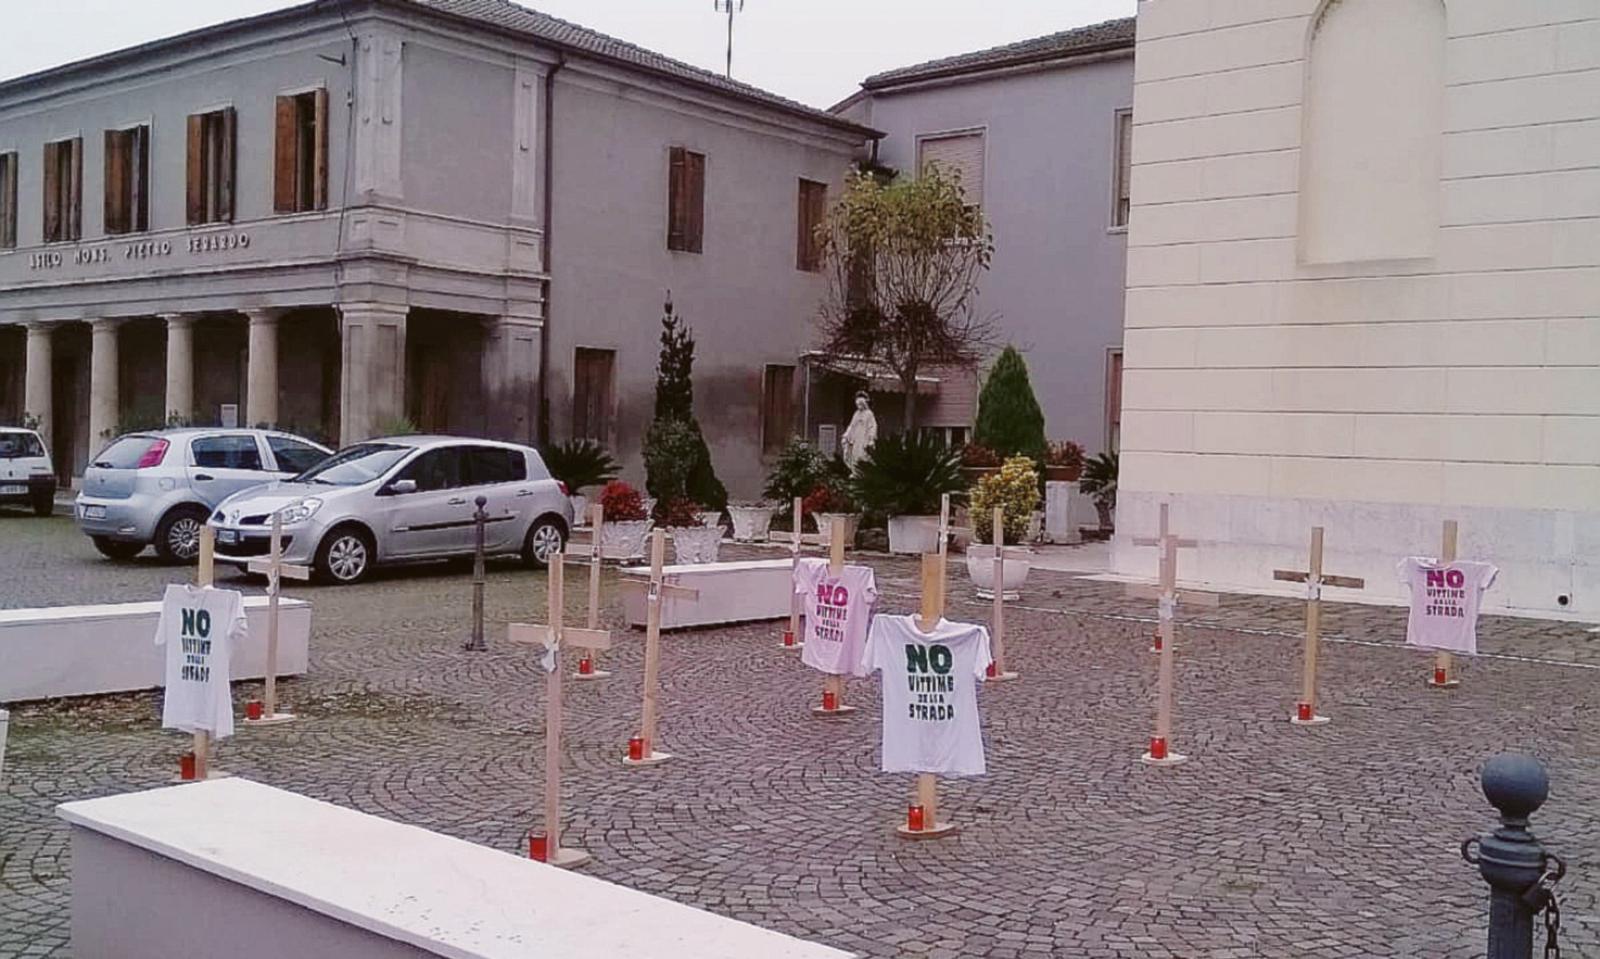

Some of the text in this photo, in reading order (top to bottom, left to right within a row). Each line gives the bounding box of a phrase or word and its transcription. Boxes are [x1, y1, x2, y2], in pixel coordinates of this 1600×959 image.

[1427, 570, 1464, 588] NO
[817, 584, 848, 606] NO
[1427, 589, 1465, 599] VITTIME
[1426, 605, 1464, 617] STRADA
[181, 608, 211, 638] NO
[905, 644, 953, 674] NO
[908, 675, 954, 692] VITTIME
[909, 704, 955, 720] STRADA
